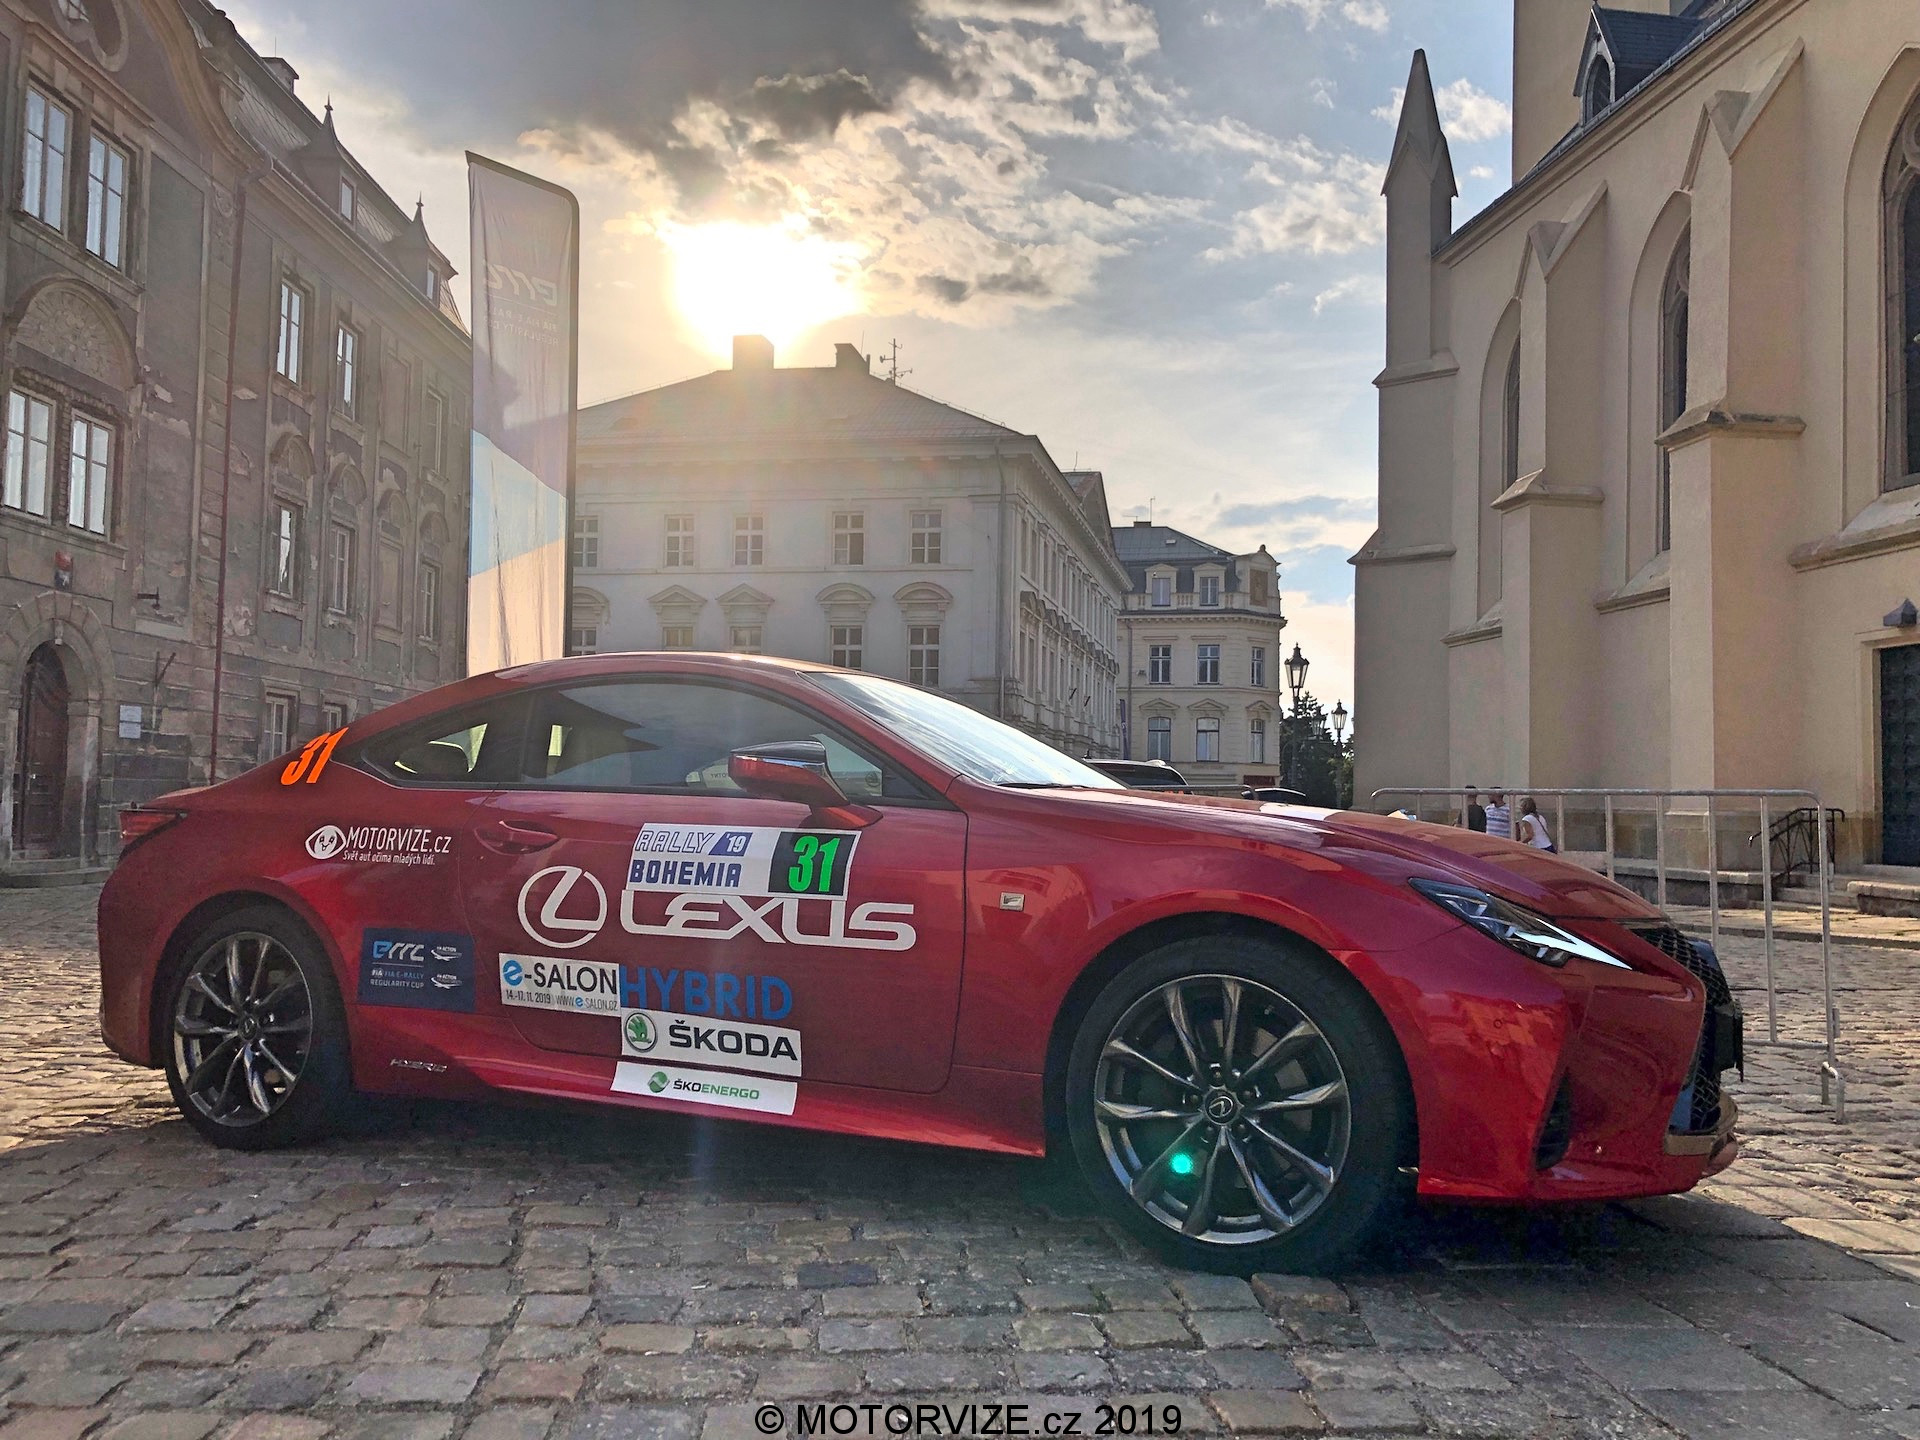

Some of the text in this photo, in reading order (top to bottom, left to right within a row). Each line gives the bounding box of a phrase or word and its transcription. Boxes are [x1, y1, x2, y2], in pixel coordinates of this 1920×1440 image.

[281, 727, 349, 786] 31
[635, 830, 715, 853] RALLY
[629, 859, 742, 888] BOHEMIA
[788, 835, 841, 893] 31
[619, 889, 917, 951] LEXUS
[534, 992, 551, 1004] 2019
[620, 964, 793, 1022] HYBRID
[668, 1019, 798, 1061] ŠKODA
[673, 1078, 760, 1100] ŠKOENERGO
